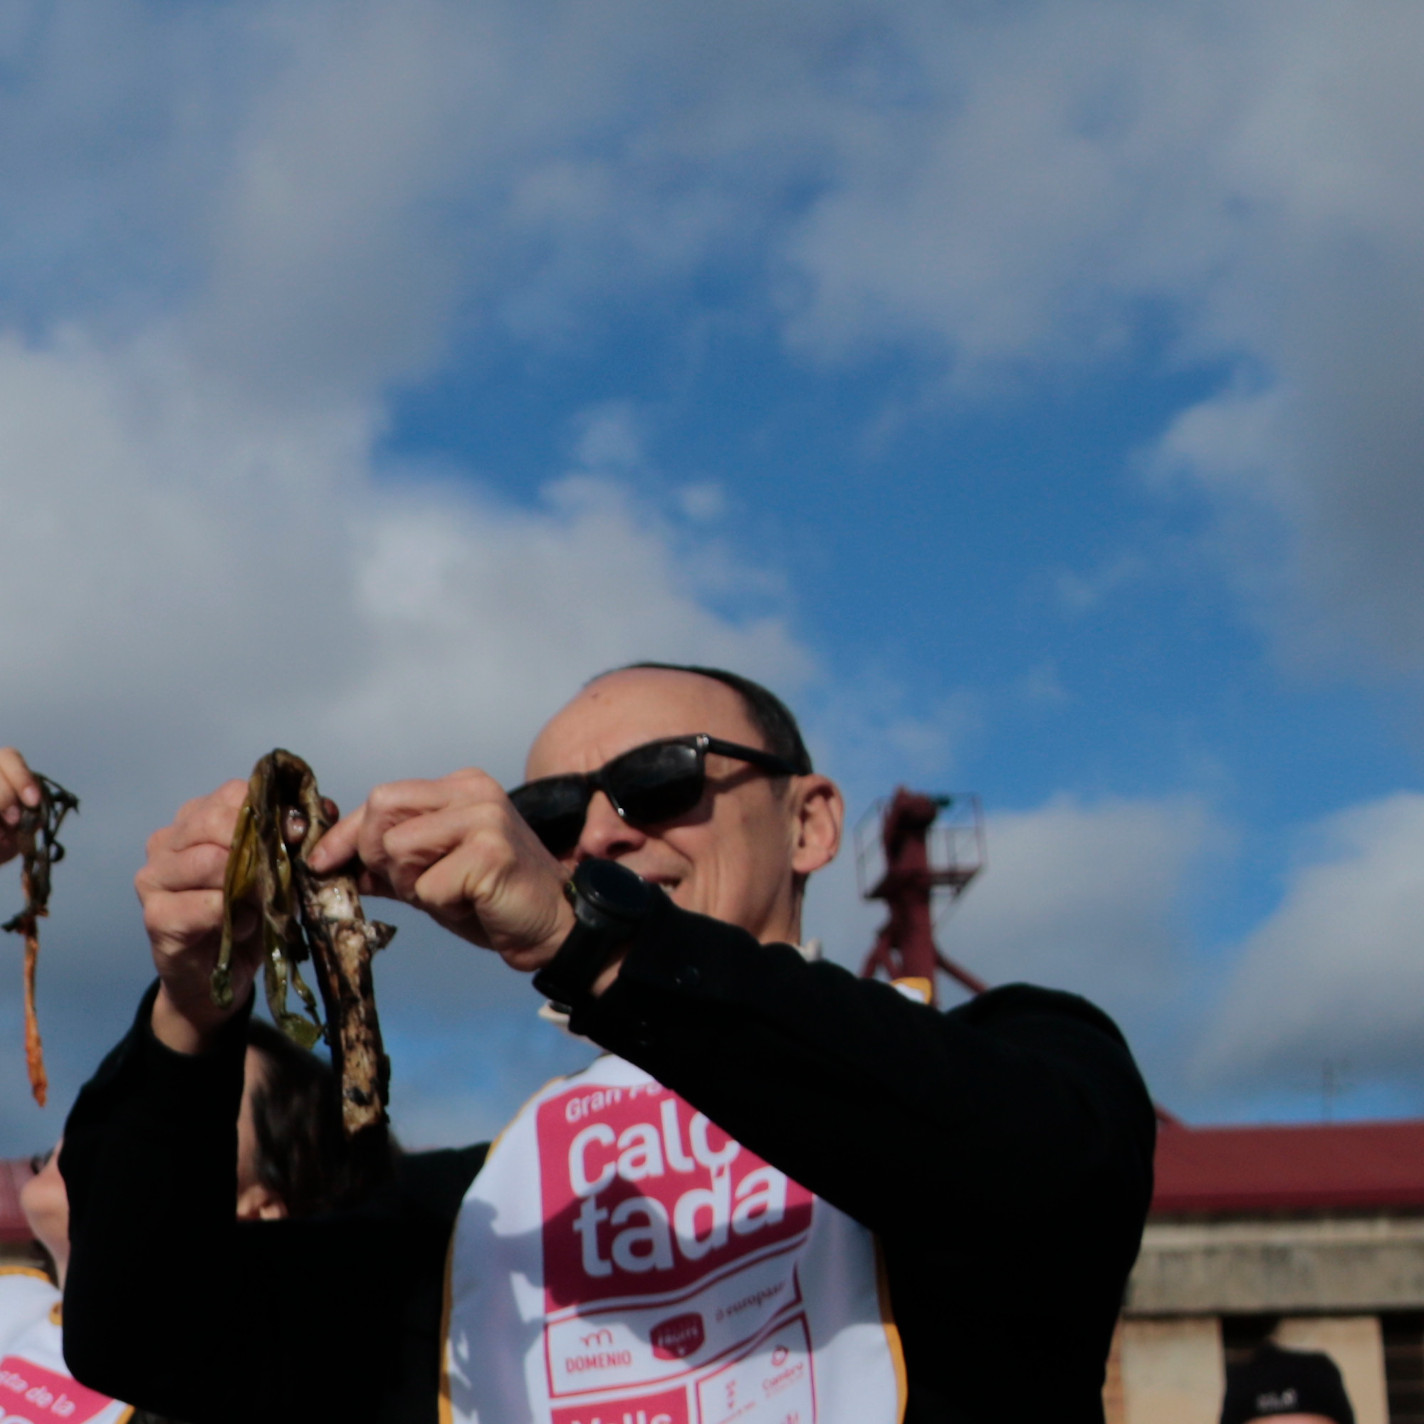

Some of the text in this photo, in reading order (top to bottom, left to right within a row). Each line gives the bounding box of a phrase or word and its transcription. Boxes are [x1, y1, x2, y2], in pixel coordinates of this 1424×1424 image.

[565, 1087, 623, 1124] Gran
[568, 1098, 741, 1197] Calç
[572, 1163, 789, 1279] tada
[565, 1350, 632, 1374] DOMENIO
